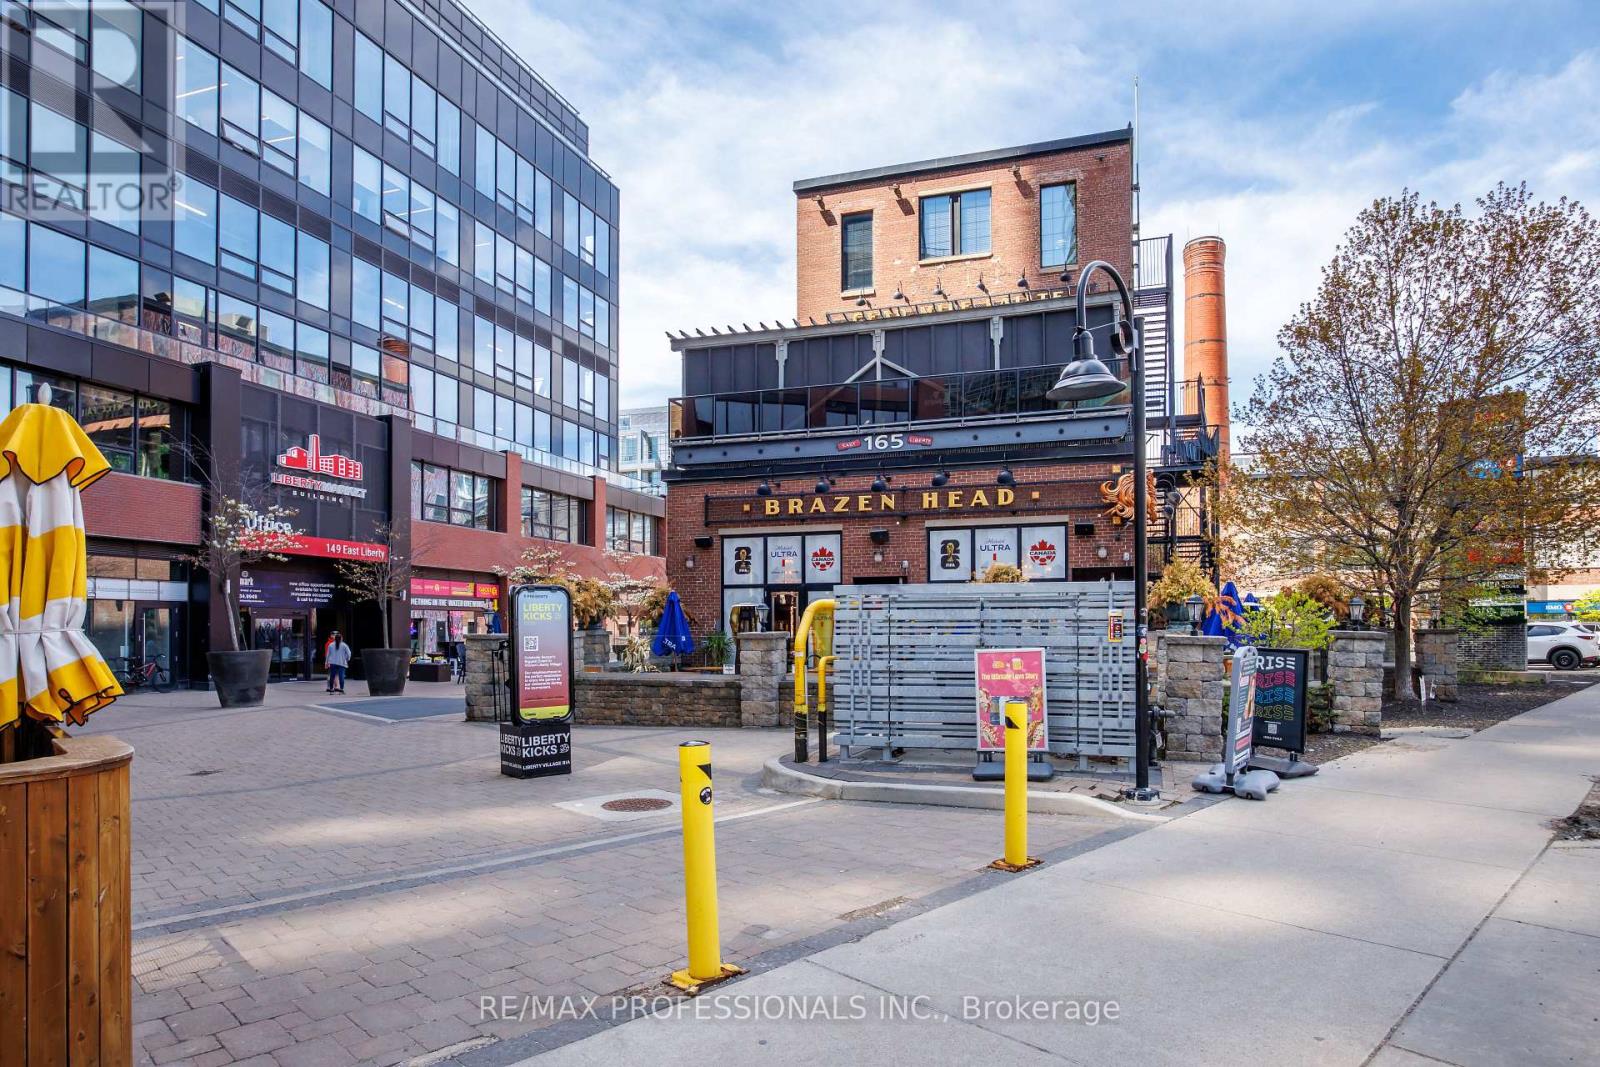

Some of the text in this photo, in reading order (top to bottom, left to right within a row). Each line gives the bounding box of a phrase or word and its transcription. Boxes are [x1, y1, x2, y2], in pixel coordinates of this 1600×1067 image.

[863, 433, 904, 450] 165
[292, 490, 344, 503] BUILDING
[765, 489, 1015, 516] BRAZEN HEAD
[326, 543, 385, 559] 149 East Liberty
[770, 550, 798, 558] ULTRA
[980, 544, 1011, 552] ULTRA
[523, 602, 563, 612] LIBERTY
[523, 612, 552, 621] KICKS
[1255, 655, 1296, 670] RISE
[1255, 671, 1296, 688] RISE
[1255, 687, 1295, 704] RISE
[1254, 704, 1294, 720] RISE
[500, 733, 521, 746] LIBERTY
[522, 732, 570, 747] LIBERTY
[501, 744, 516, 756] KICKS
[522, 745, 558, 758] KICKS
